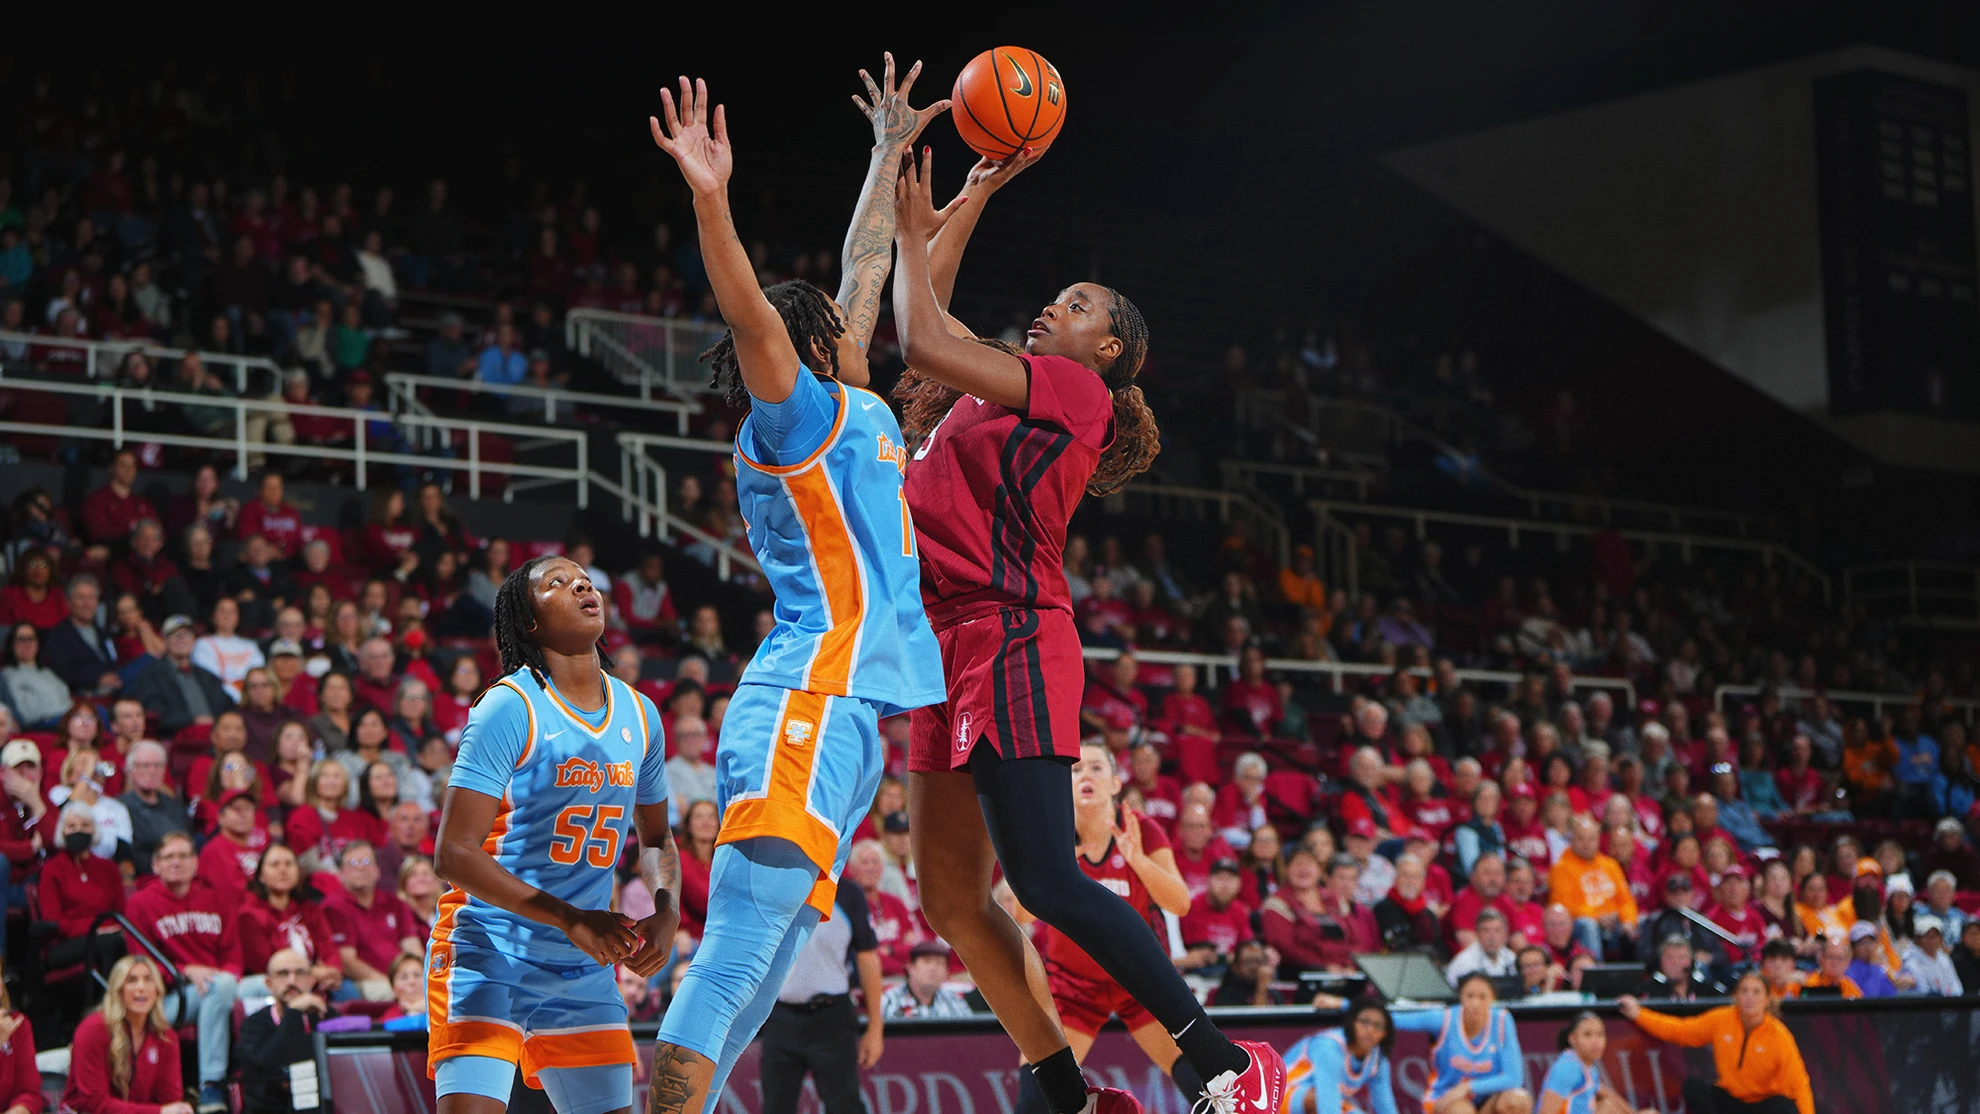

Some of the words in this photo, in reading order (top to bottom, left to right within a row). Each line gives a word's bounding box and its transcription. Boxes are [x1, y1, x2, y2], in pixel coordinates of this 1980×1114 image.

[554, 756, 605, 794] Lady
[604, 759, 635, 787] Vols
[548, 804, 625, 869] 55
